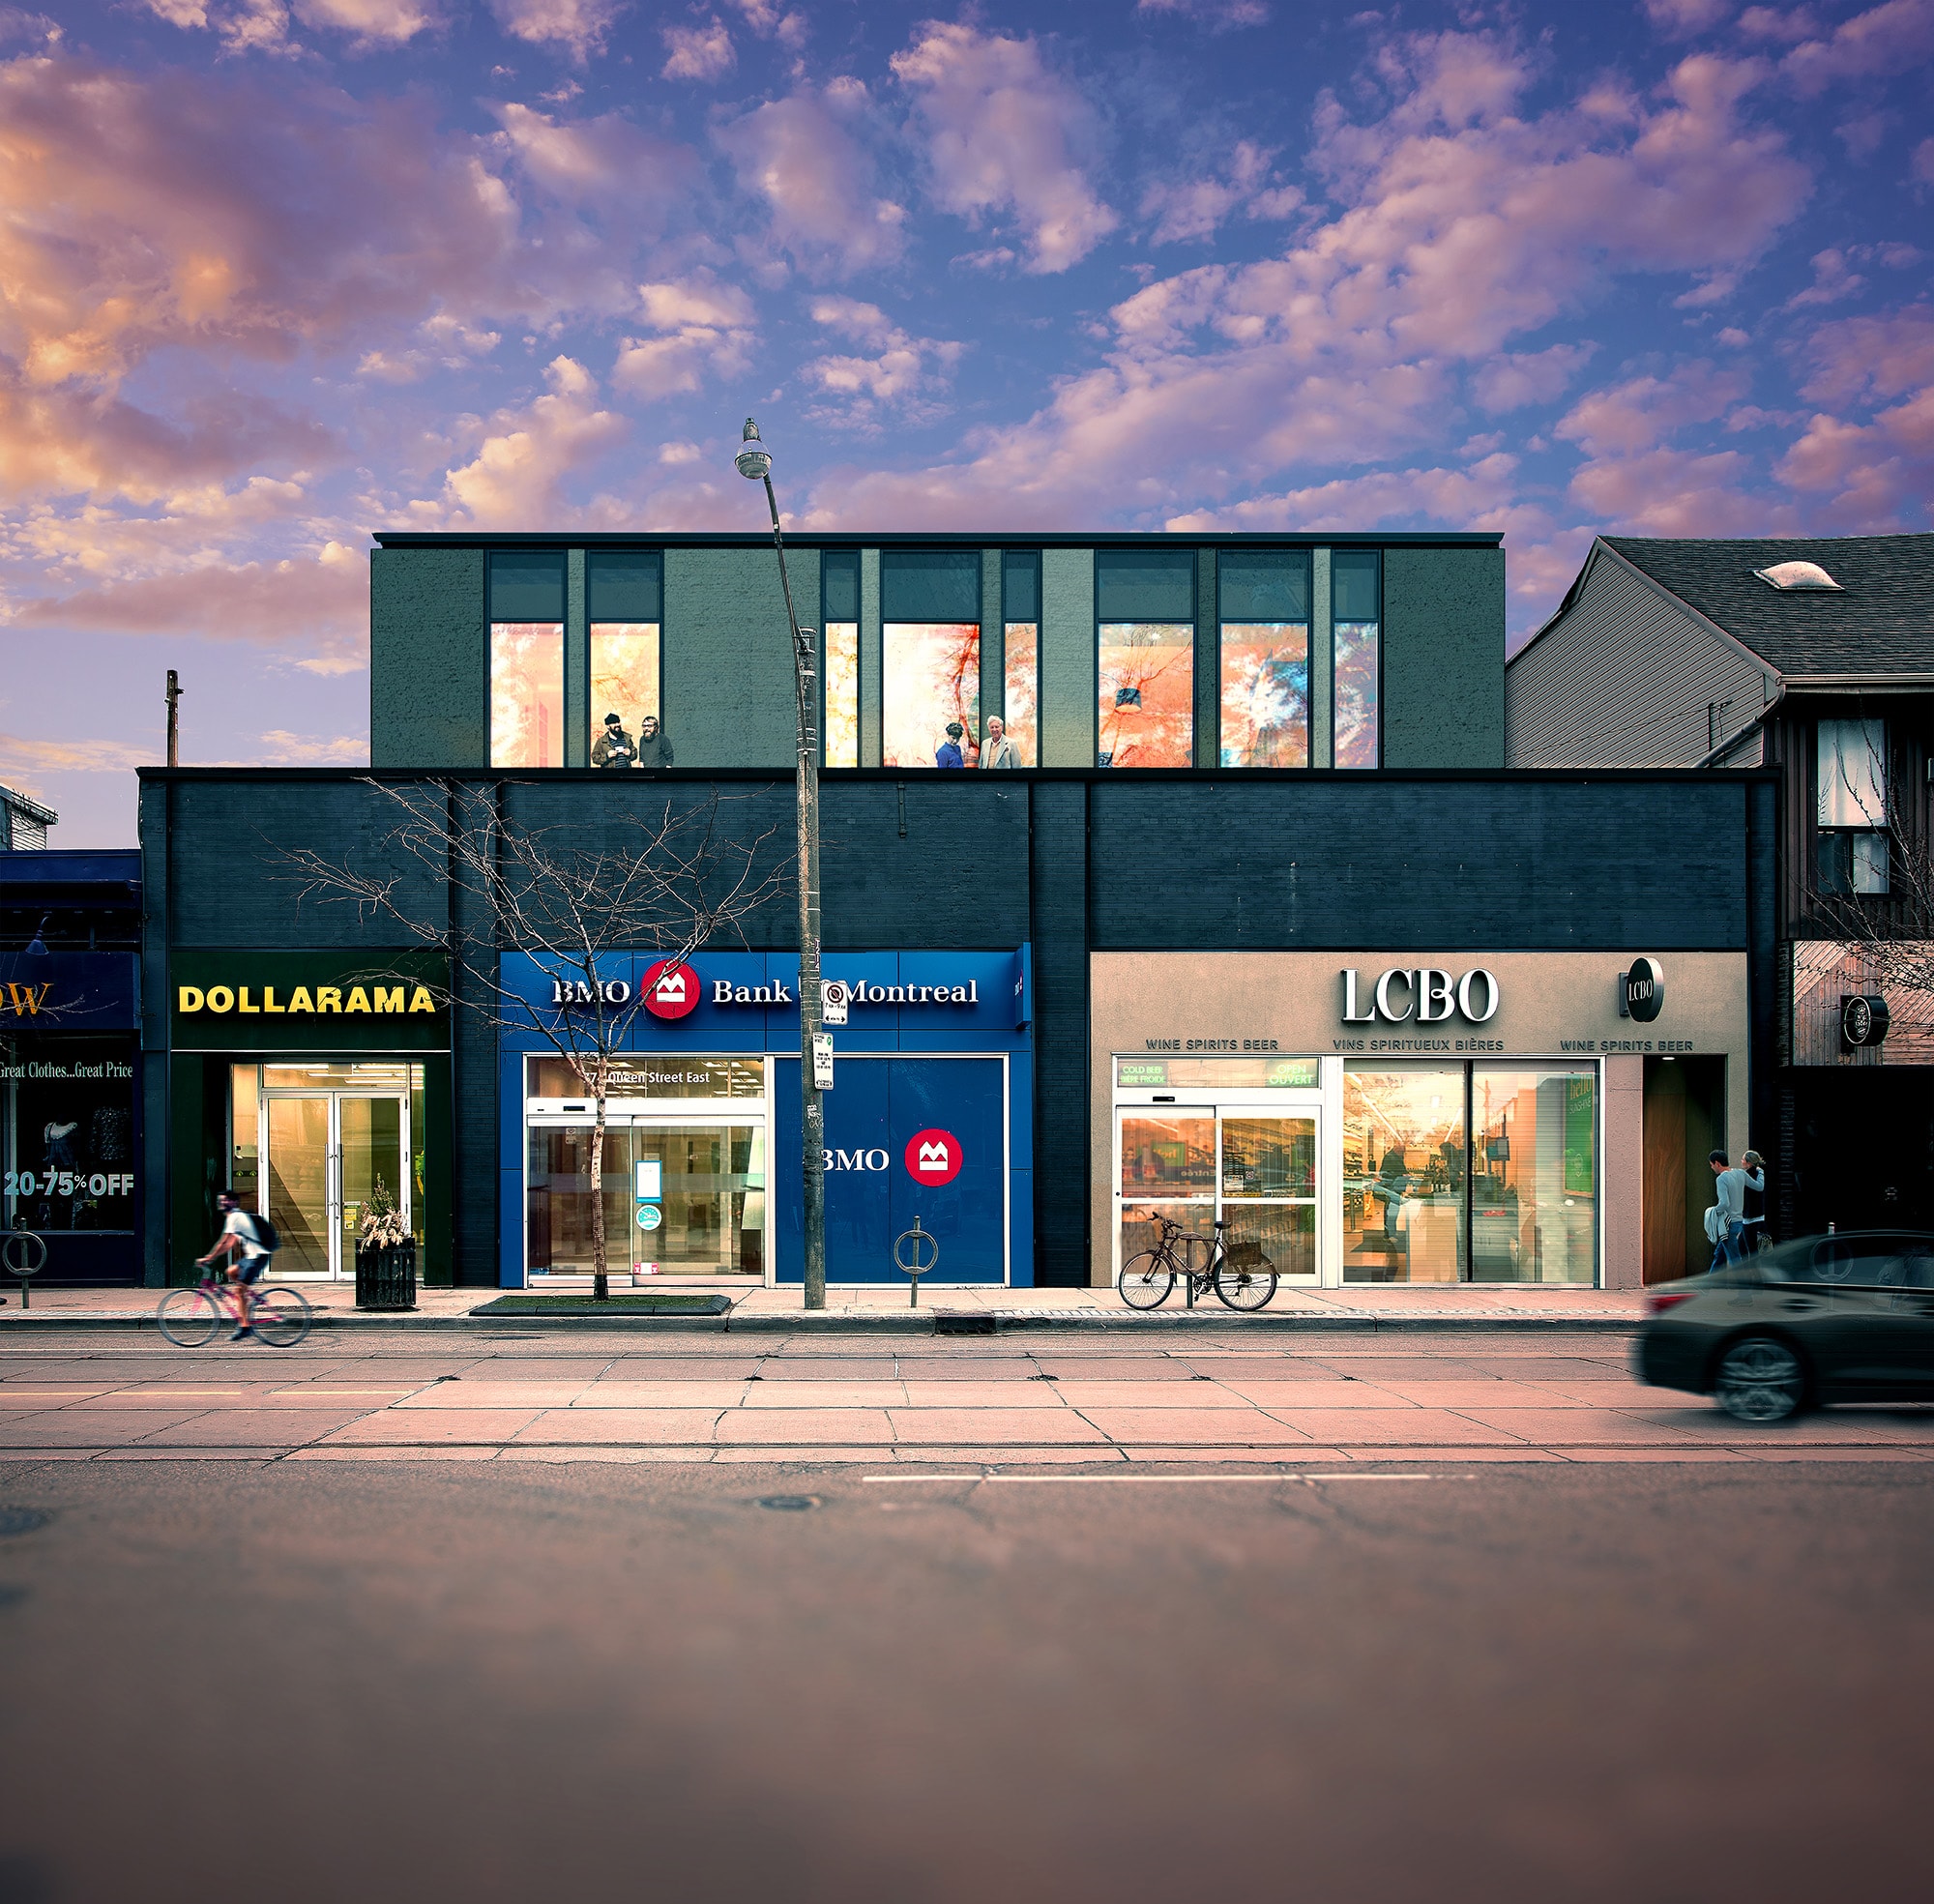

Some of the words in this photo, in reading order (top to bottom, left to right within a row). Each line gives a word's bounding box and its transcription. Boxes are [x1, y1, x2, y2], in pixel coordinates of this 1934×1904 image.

[552, 980, 630, 1003] BMO
[712, 979, 793, 1003] Bank
[837, 979, 979, 1003] Montreal
[1341, 967, 1501, 1022] LCBO
[1628, 979, 1653, 1002] LCBO
[0, 981, 54, 1016] W
[178, 985, 436, 1013] DOLLARAMA
[1146, 1039, 1181, 1050] WINE
[1186, 1039, 1238, 1050] SPIRITS
[1243, 1039, 1278, 1050] BEER
[1333, 1039, 1365, 1051] VINS
[1370, 1039, 1450, 1051] SPIRITUEUX
[1454, 1037, 1505, 1051] BIÈRES
[1560, 1040, 1596, 1051] WINE
[1600, 1040, 1653, 1051] SPIRITS
[1657, 1040, 1694, 1051] BEER
[105, 1061, 133, 1078] Price
[1122, 1066, 1146, 1074] COLD
[1146, 1066, 1163, 1074] BEER
[1276, 1064, 1306, 1074] OPEN
[607, 1071, 646, 1085] Queen
[648, 1071, 683, 1084] Street
[686, 1071, 711, 1084] East
[1269, 1074, 1313, 1085] OUVERT
[821, 1148, 890, 1171] BMO
